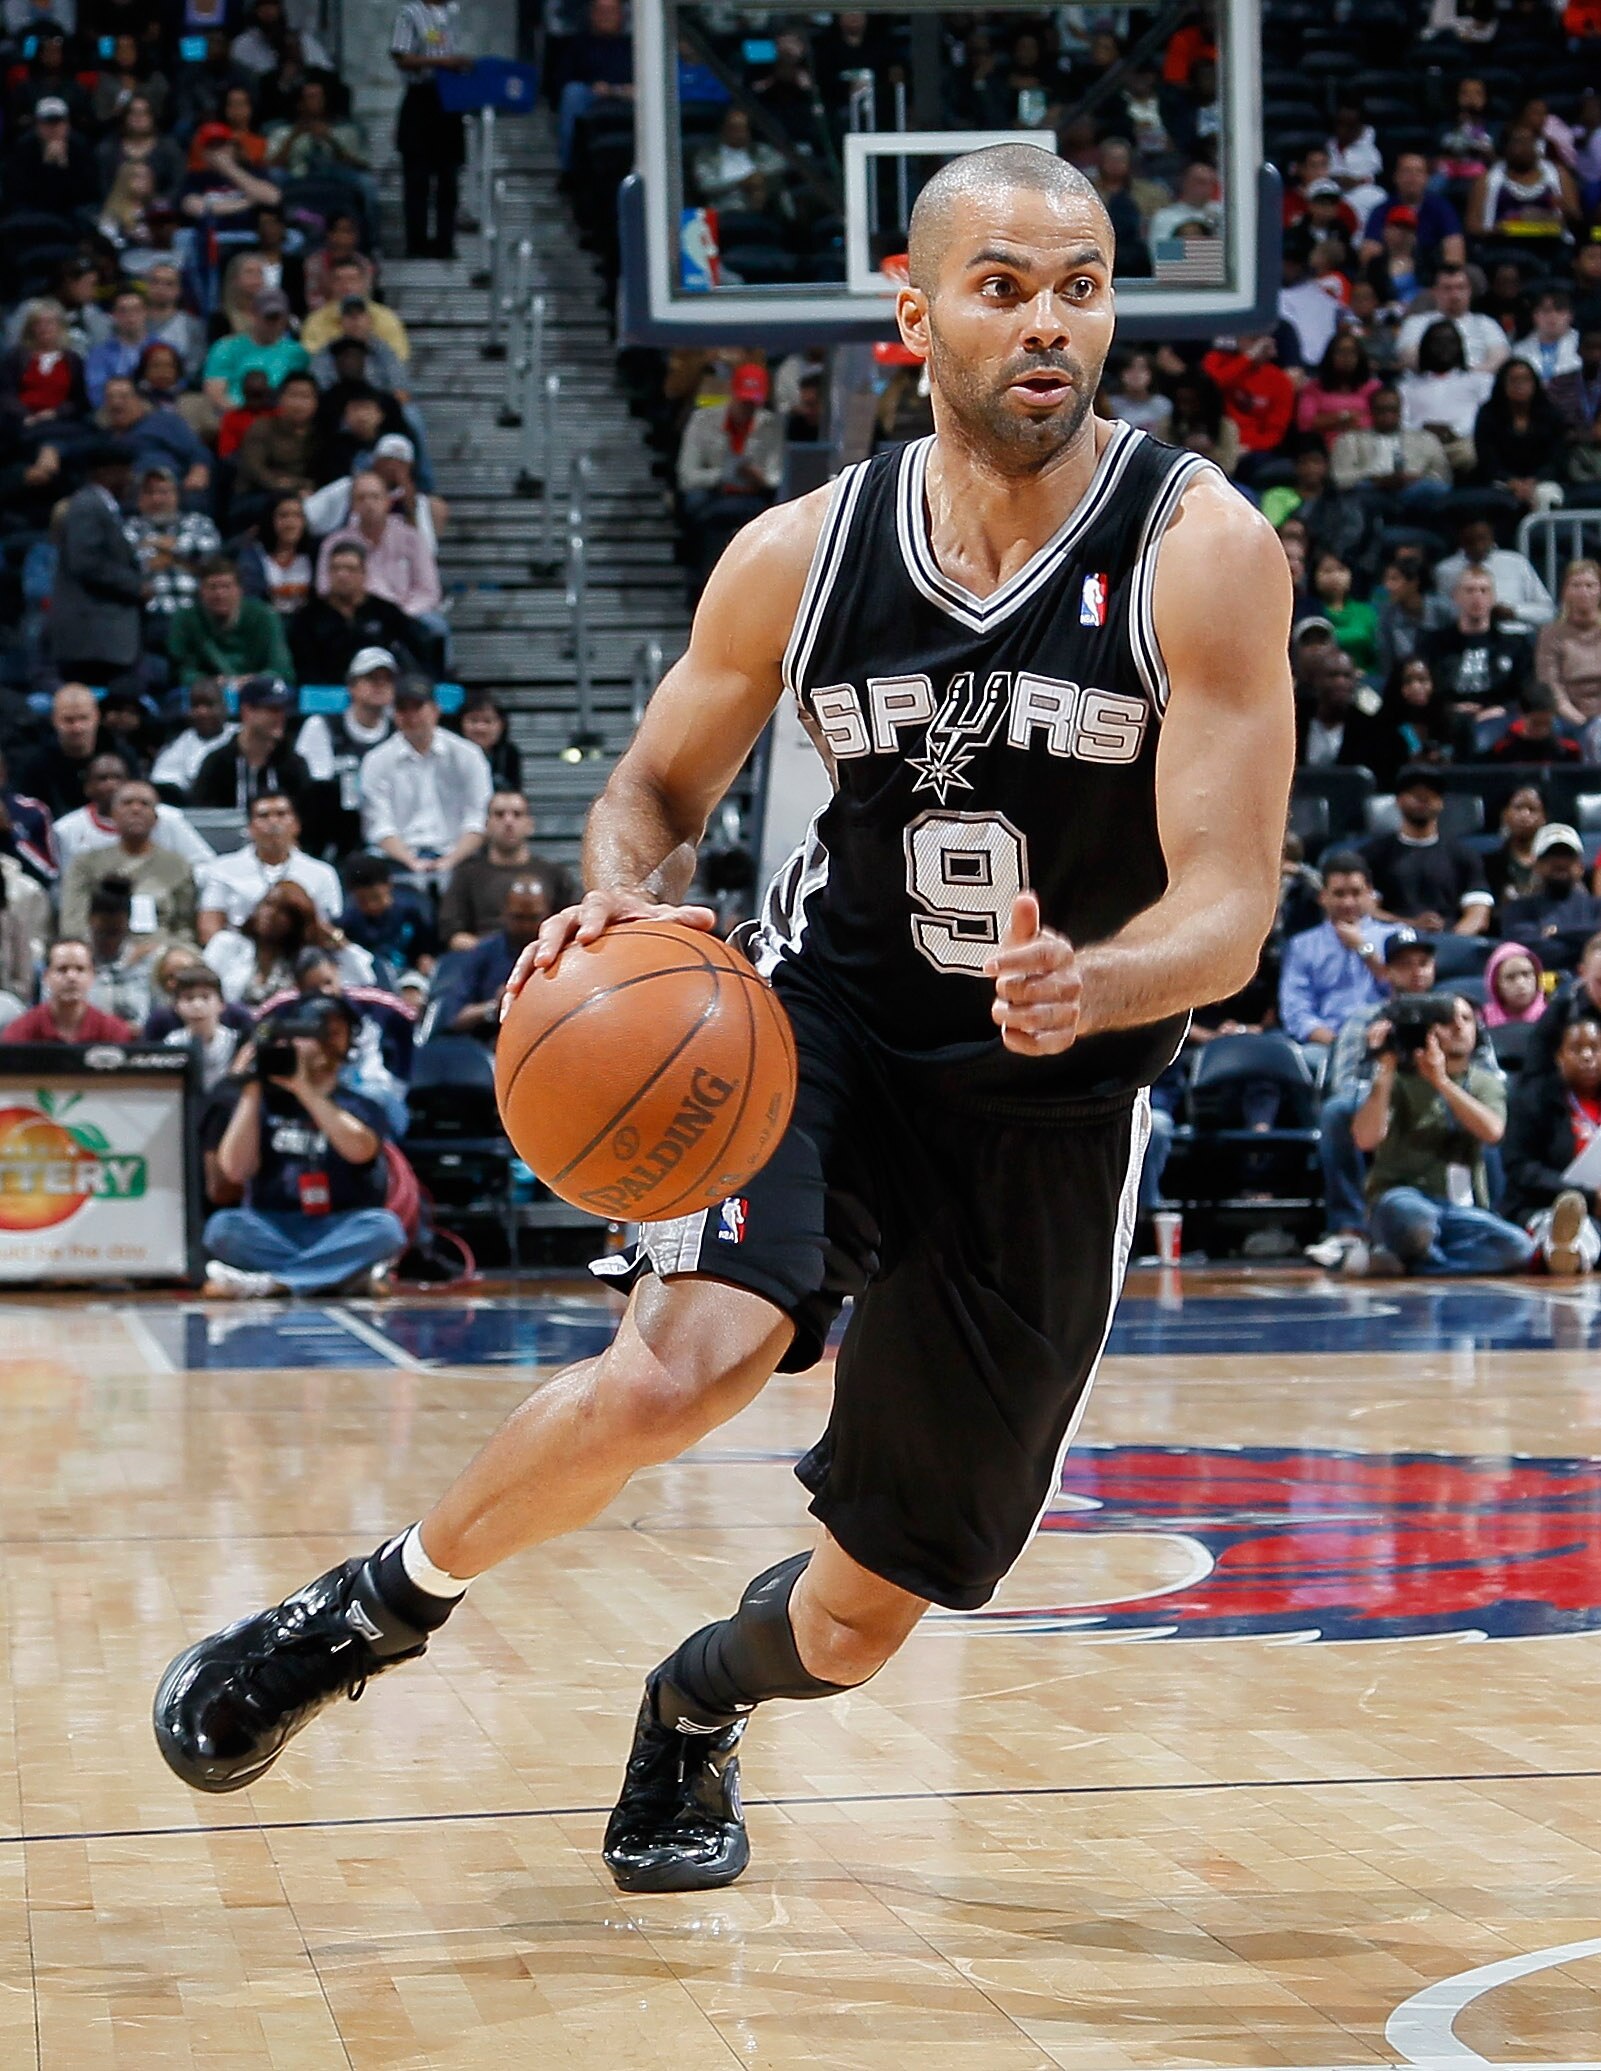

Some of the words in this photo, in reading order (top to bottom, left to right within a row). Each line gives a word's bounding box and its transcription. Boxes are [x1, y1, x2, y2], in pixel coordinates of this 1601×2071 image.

[811, 671, 1150, 766] SPURS
[903, 808, 1031, 977] 9
[578, 1066, 736, 1215] SPALDING
[718, 1230, 735, 1241] NBA
